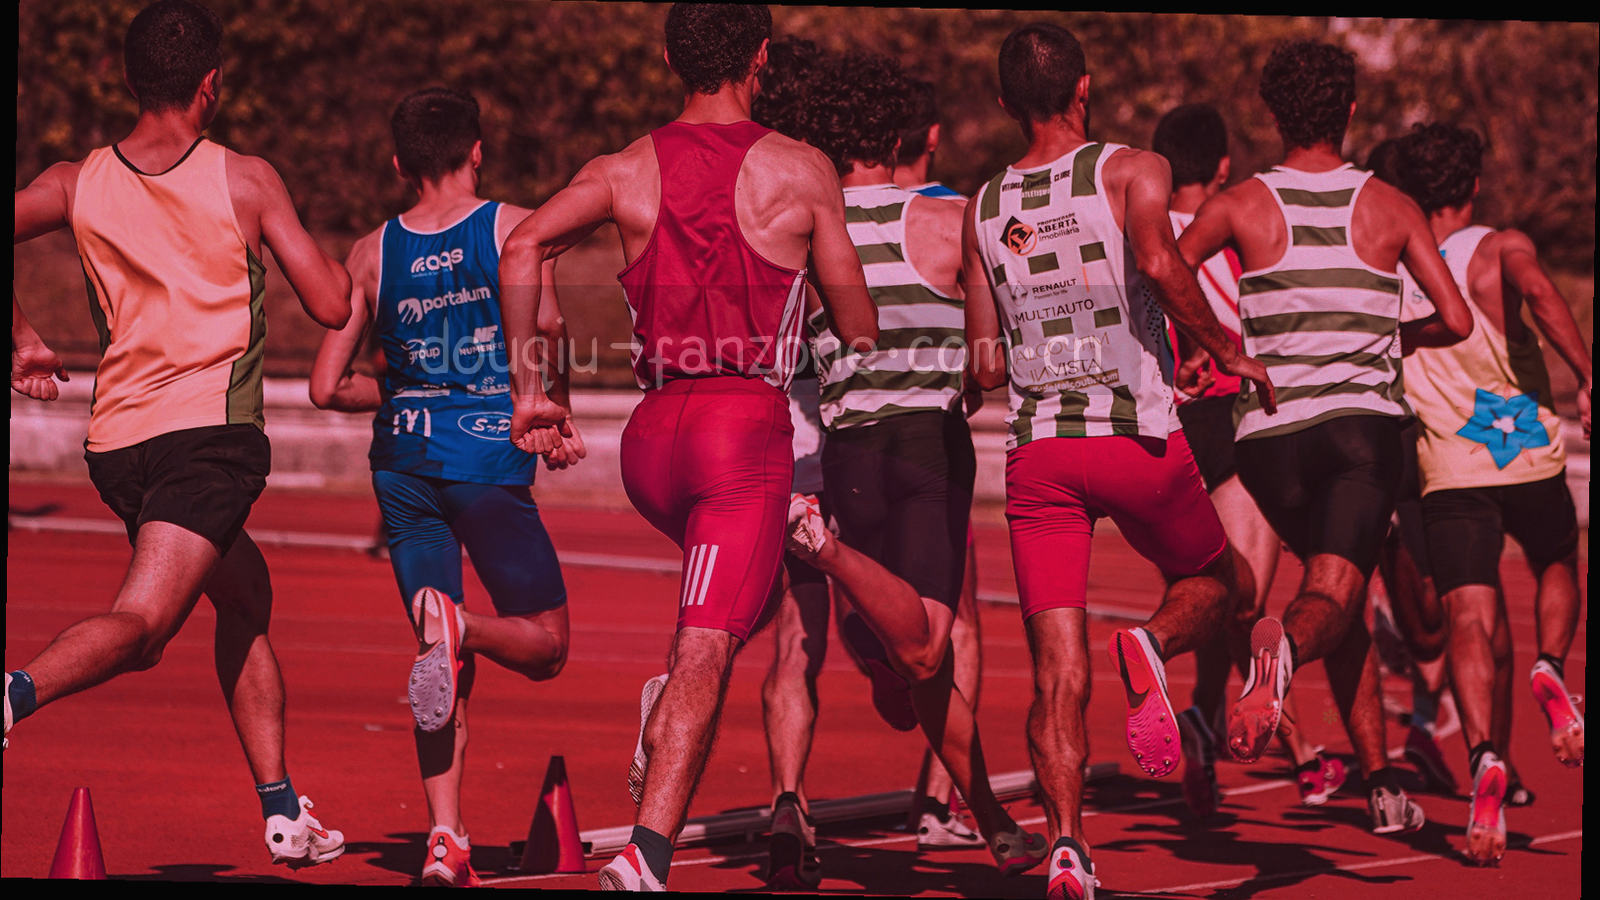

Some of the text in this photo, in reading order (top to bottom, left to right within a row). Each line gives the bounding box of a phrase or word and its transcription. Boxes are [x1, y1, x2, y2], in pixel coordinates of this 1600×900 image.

[1037, 218, 1079, 234] ABERTA
[1032, 278, 1077, 295] RENAULT
[423, 286, 491, 314] portalum
[1014, 299, 1095, 323] MULTIAUTO
[408, 346, 441, 366] group
[1015, 331, 1111, 365] ALCOUTIM
